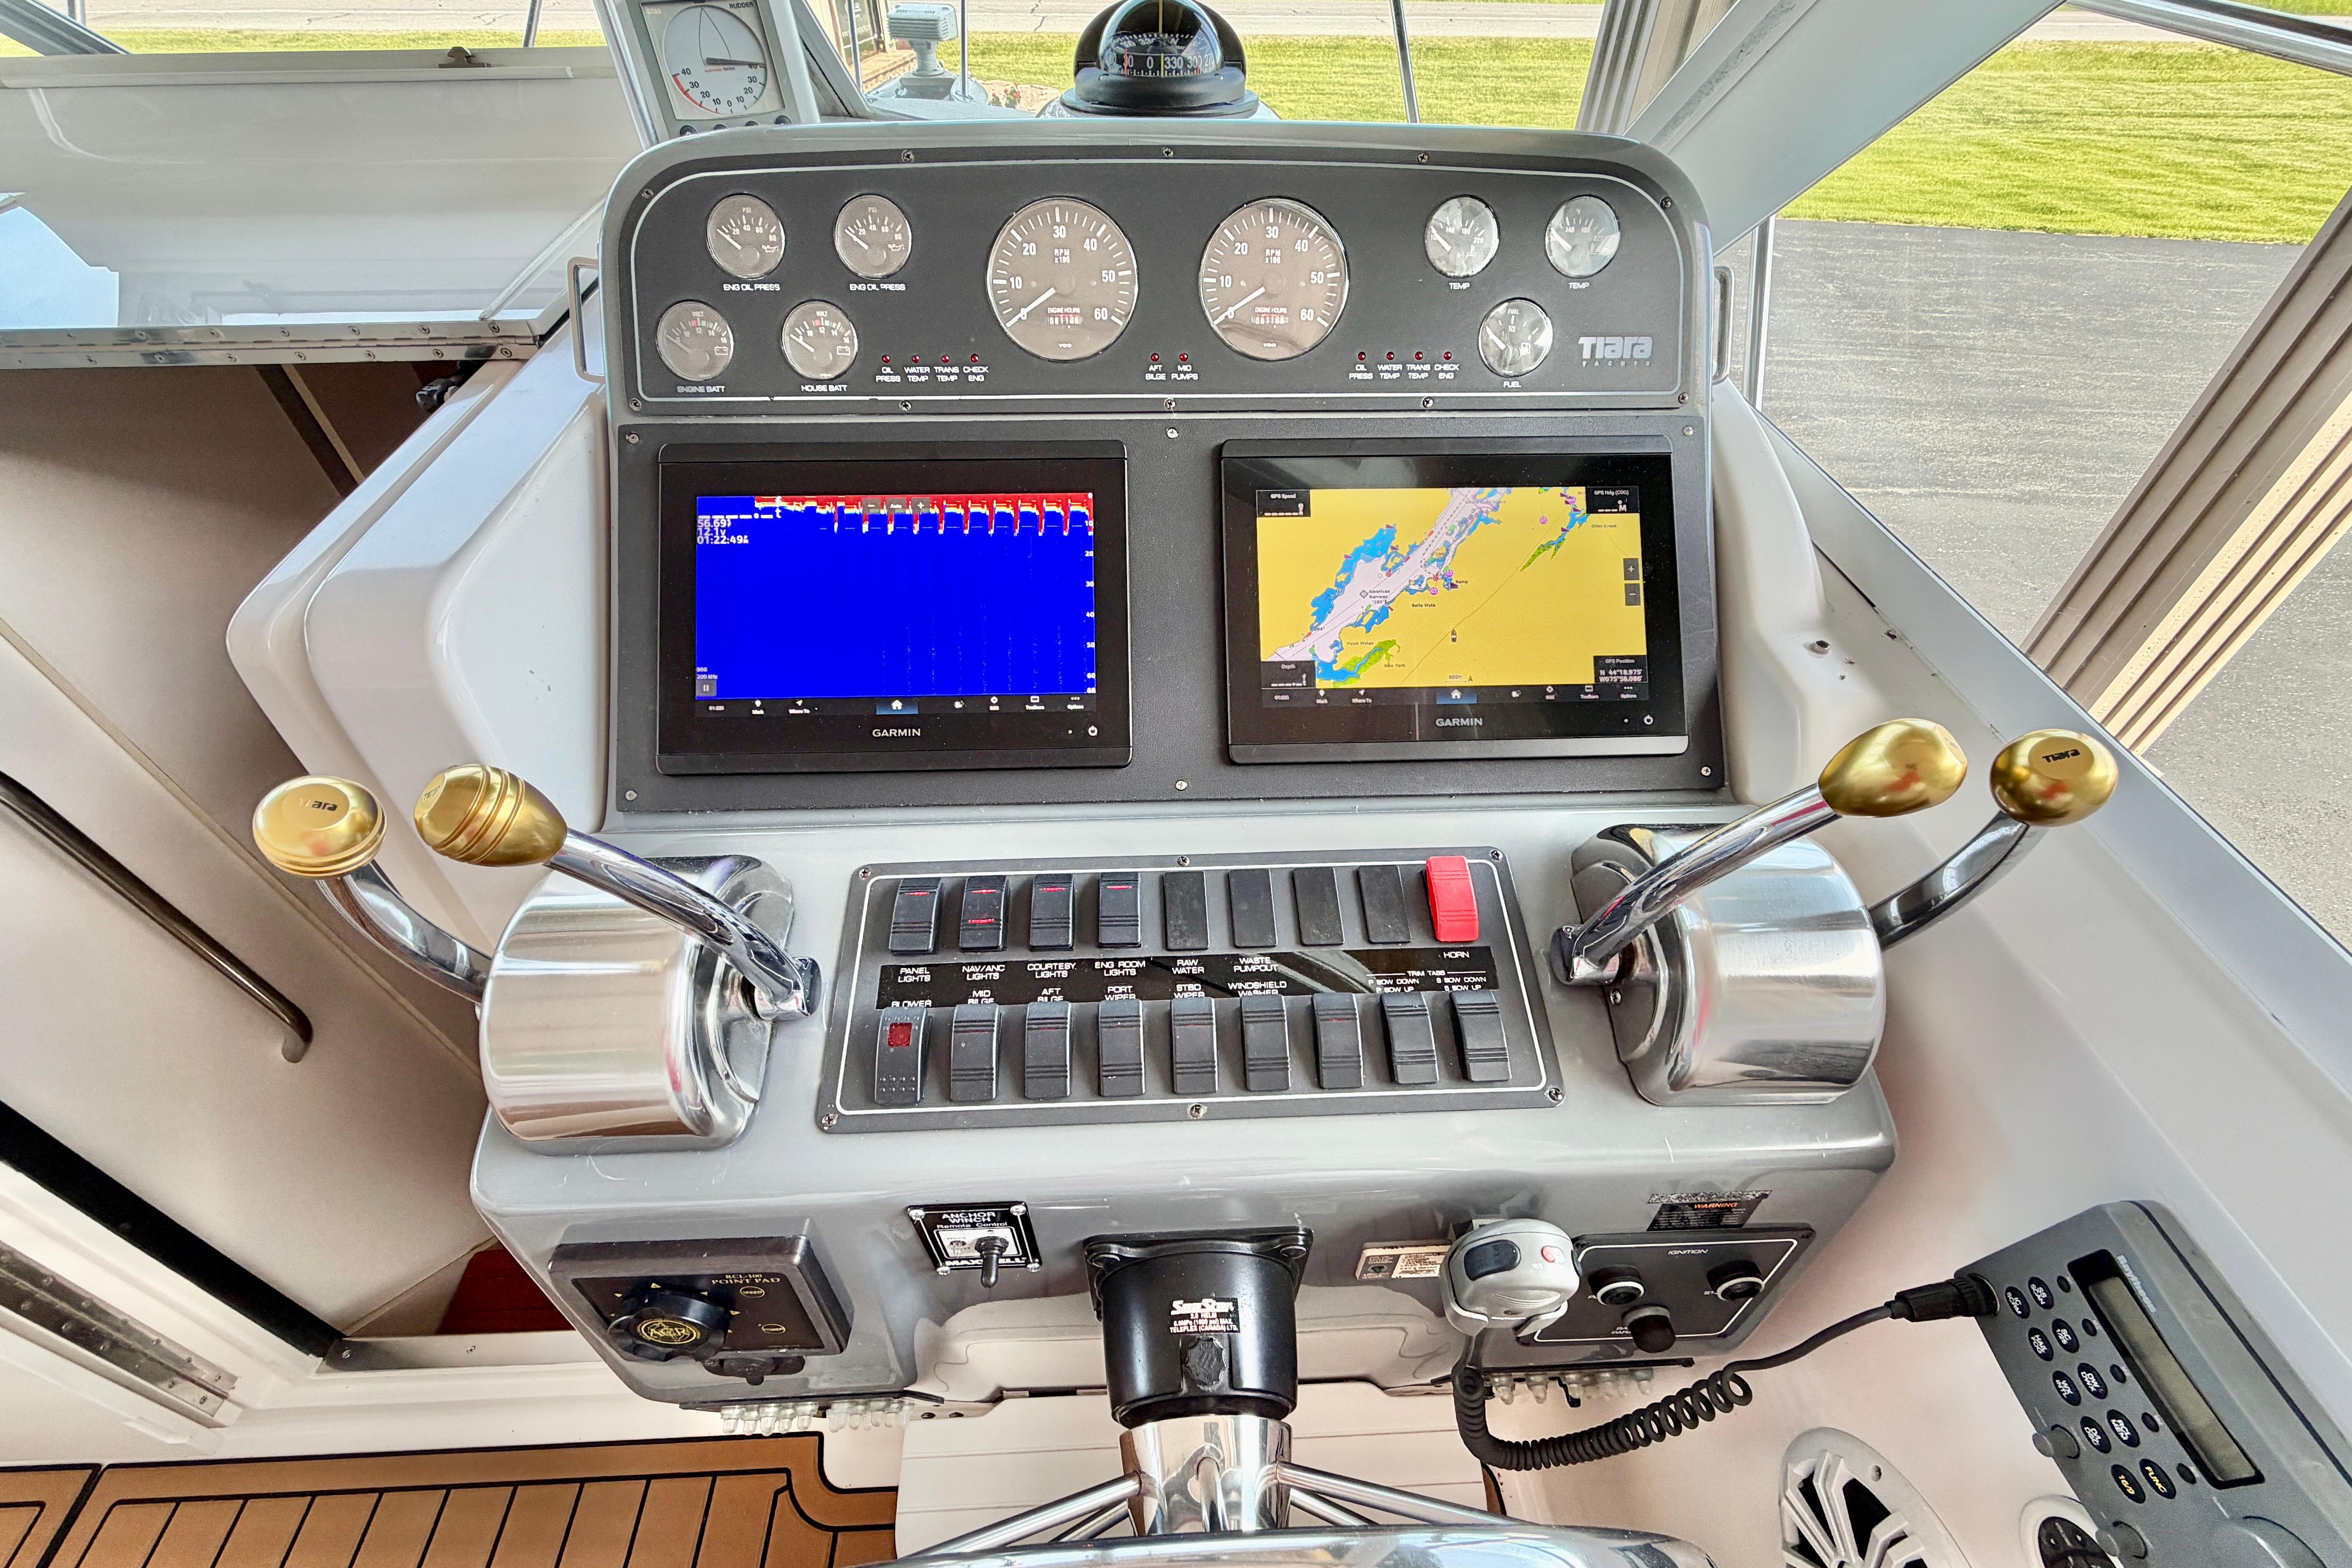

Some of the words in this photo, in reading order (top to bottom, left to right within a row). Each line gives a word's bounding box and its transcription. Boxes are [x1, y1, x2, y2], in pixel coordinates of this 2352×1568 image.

[1146, 56, 1153, 69] 0
[1164, 56, 1183, 69] 330
[1053, 225, 1066, 238] 30
[1266, 226, 1279, 238] 30
[1023, 243, 1036, 255] 20
[1084, 238, 1097, 251] 40
[1234, 242, 1248, 255] 20
[1295, 240, 1308, 252] 40
[1010, 276, 1022, 289] 10
[1102, 270, 1115, 282] 50
[1220, 275, 1232, 287] 10
[1311, 272, 1324, 284] 50
[1094, 308, 1108, 320] 60
[1300, 308, 1314, 321] 60
[1436, 718, 1483, 727] GARMIN
[872, 728, 921, 737] GARMIN
[1228, 981, 1287, 989] WINDSHIELD
[2030, 1284, 2045, 1305] SCAN
[2061, 1328, 2072, 1341] SC
[2060, 1380, 2073, 1395] WX
[2081, 1371, 2096, 1392] DWX
[2086, 1373, 2100, 1389] DW
[2111, 1419, 2129, 1441] MEM
[2116, 1419, 2131, 1437] RCL
[2145, 1466, 2167, 1493] FUNC
